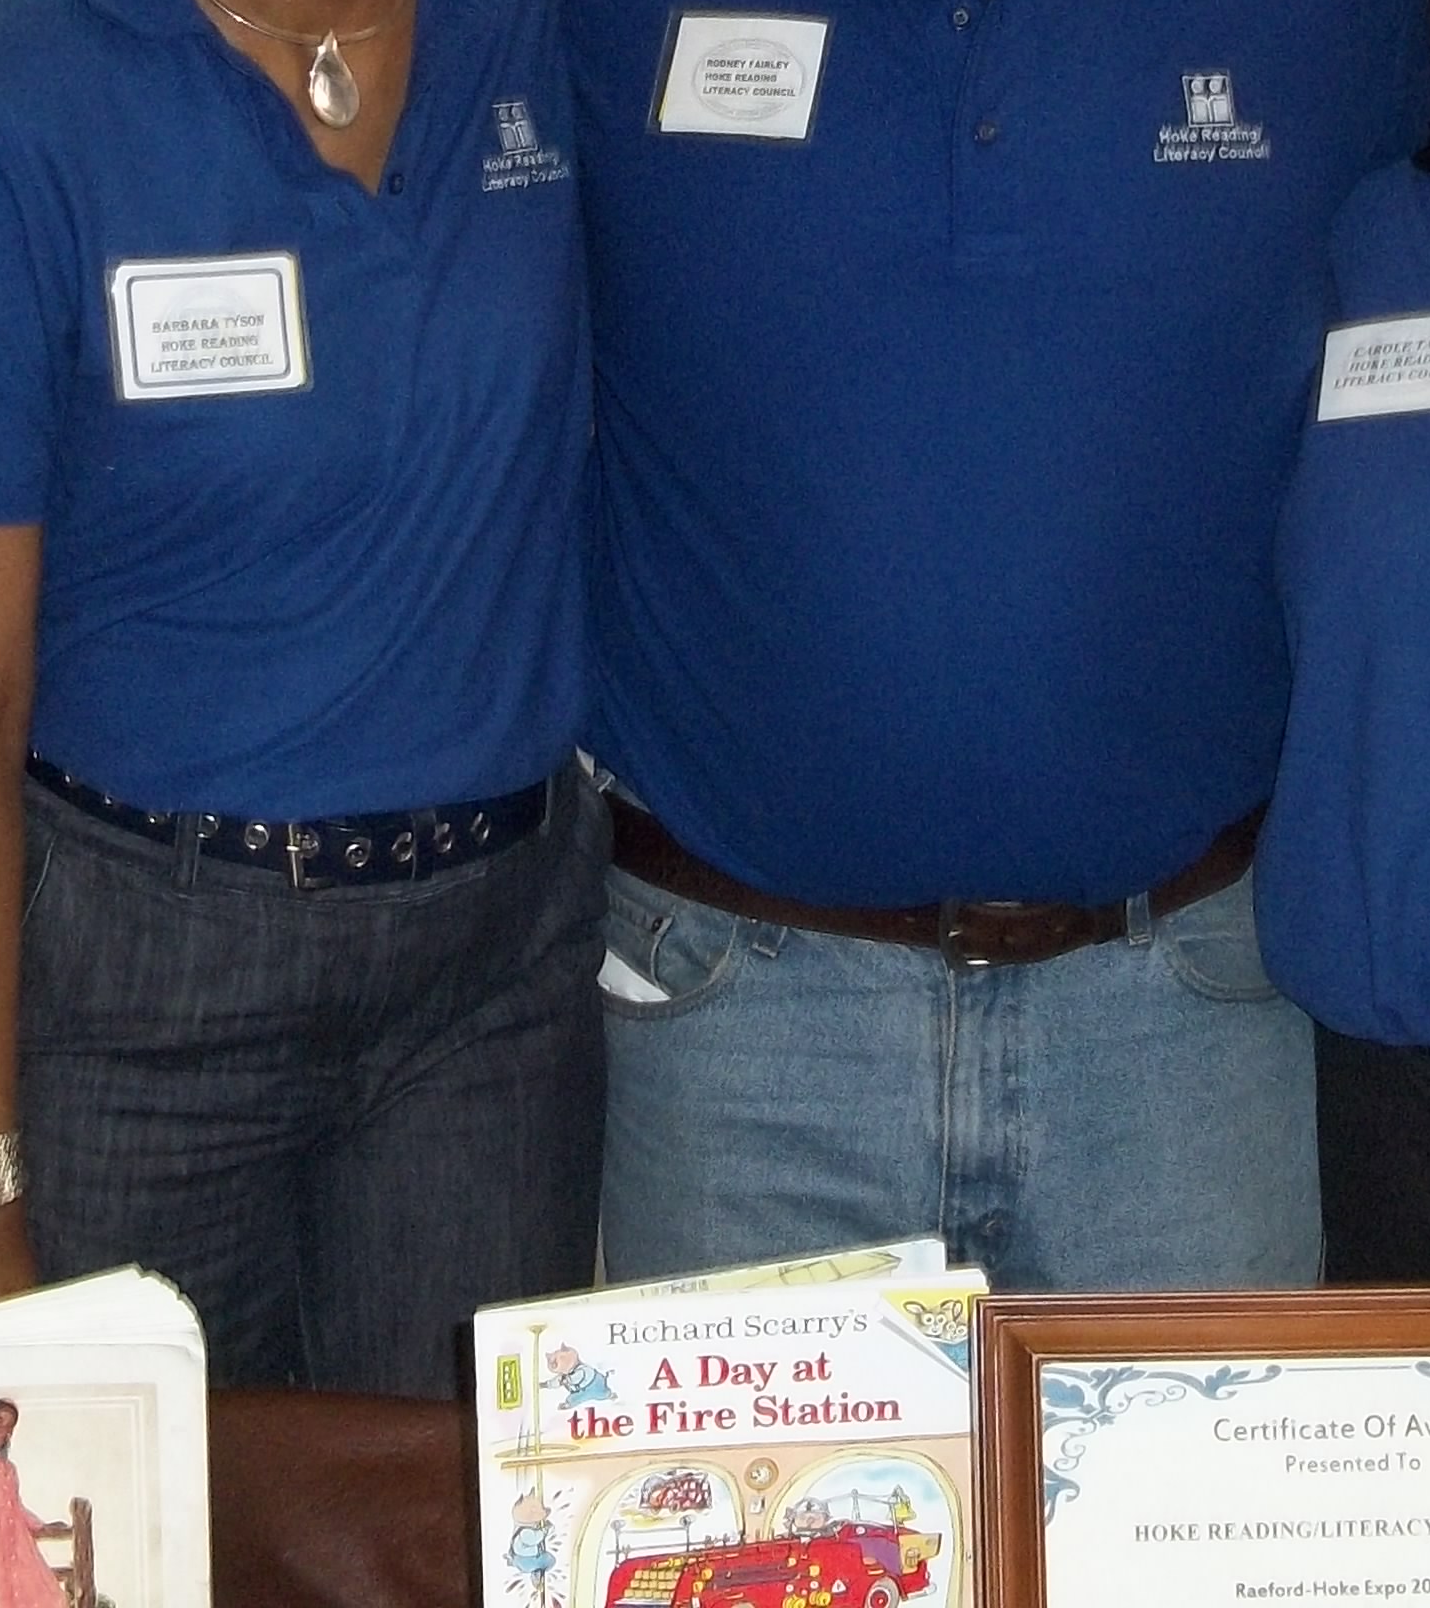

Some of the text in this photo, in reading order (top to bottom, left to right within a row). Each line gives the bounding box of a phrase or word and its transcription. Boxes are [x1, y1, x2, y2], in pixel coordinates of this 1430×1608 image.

[707, 59, 789, 69] RODNEY FAIRLEY
[705, 73, 777, 82] HOKE READING
[703, 87, 795, 97] LITERACY COUNCIL
[1159, 128, 1197, 143] Hoke
[1154, 146, 1270, 162] Literacy Council
[483, 158, 511, 171] Hoke
[152, 315, 265, 333] BARBARA TYSON
[162, 335, 259, 352] HOKE READING
[151, 354, 273, 372] LITERACY COUNCIL
[1349, 358, 1390, 372] HOKE
[1334, 372, 1404, 389] LITERACY
[608, 1309, 867, 1346] Richard Scarry's
[649, 1352, 832, 1392] A Day at
[568, 1393, 902, 1440] the Fire Station
[1213, 1417, 1355, 1443] Certificate
[1364, 1414, 1396, 1438] Of
[1285, 1454, 1421, 1473] Presented To
[1134, 1522, 1200, 1543] HOKE
[1235, 1579, 1360, 1599] Raeford-Hoke
[1364, 1579, 1406, 1601] Expo
